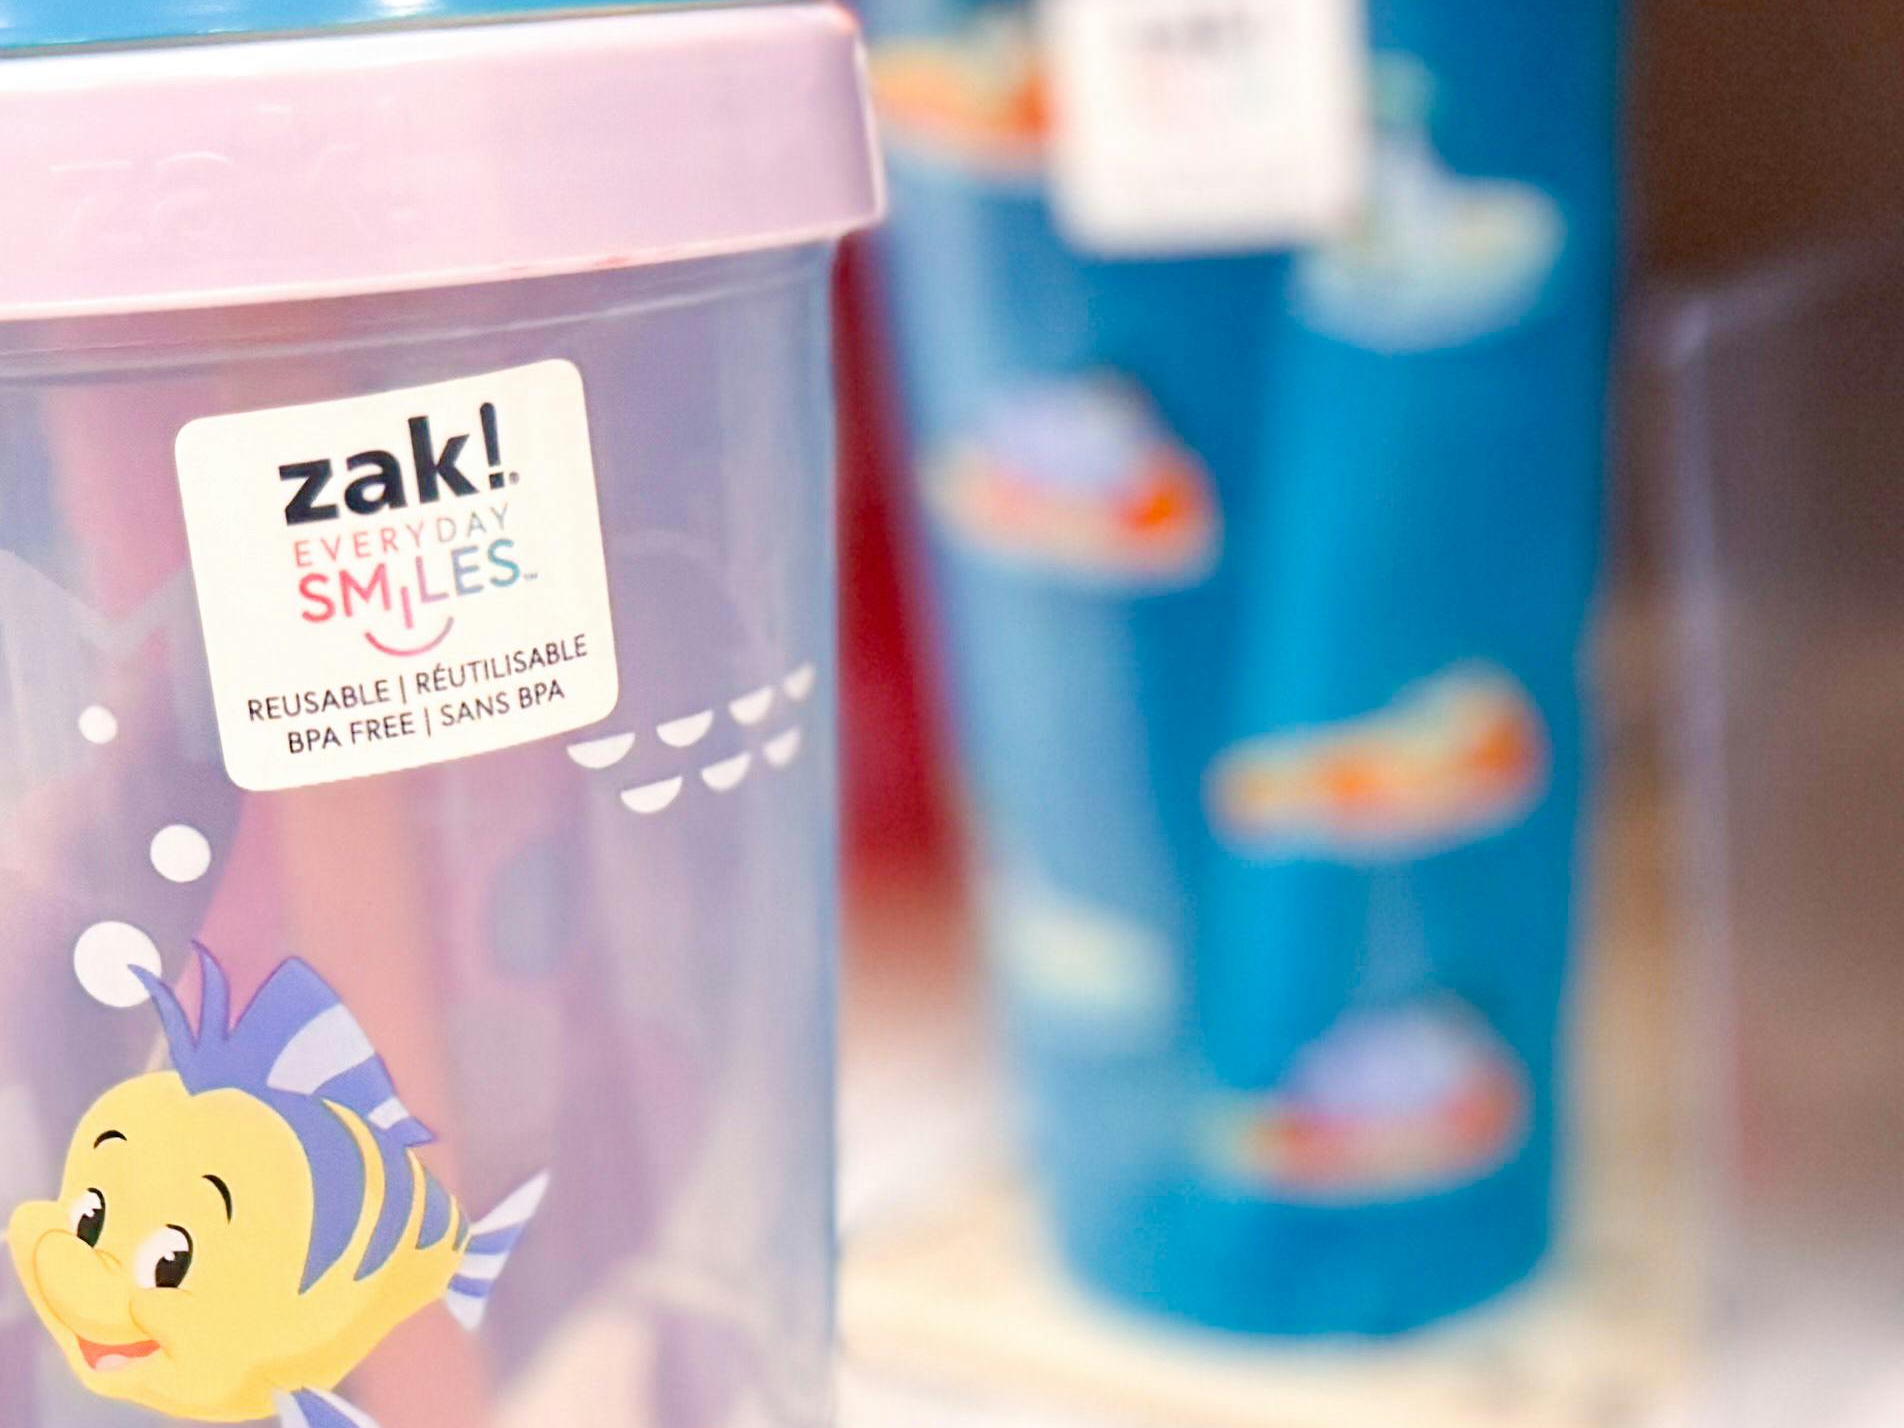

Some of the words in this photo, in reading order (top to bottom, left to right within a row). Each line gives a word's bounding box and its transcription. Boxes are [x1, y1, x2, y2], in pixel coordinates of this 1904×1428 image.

[278, 402, 508, 526] zak!
[294, 503, 510, 568] EVERYDAY
[298, 539, 522, 630] SMILES
[247, 678, 390, 722] REUSABLE
[416, 633, 588, 695] RÉUTILISABLE
[287, 726, 341, 755] BPA
[350, 713, 415, 746] FREE
[441, 693, 509, 728] SANS
[519, 679, 565, 709] BPA
